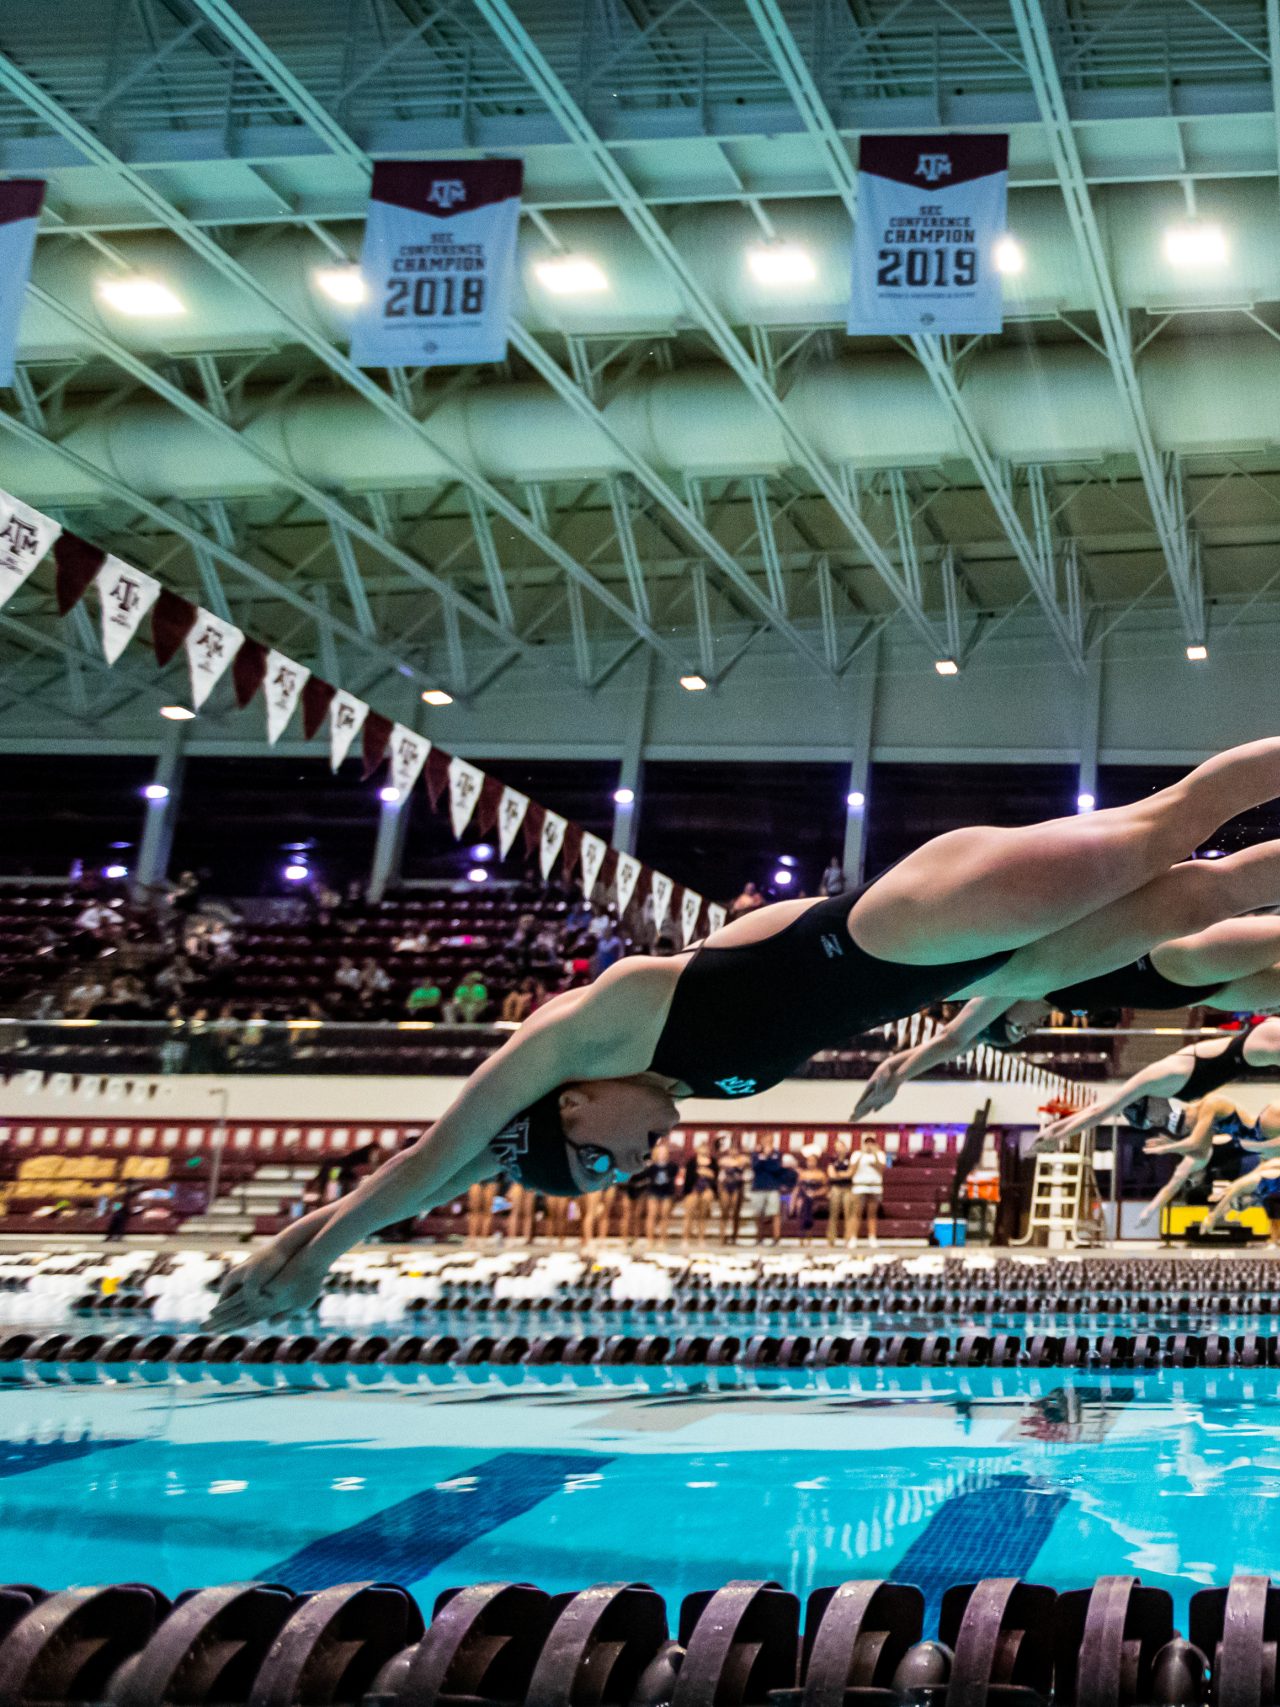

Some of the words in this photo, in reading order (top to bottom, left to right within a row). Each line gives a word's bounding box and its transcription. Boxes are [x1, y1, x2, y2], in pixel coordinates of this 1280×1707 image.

[919, 206, 943, 216] SEC
[889, 217, 971, 228] CONFERENCE
[884, 230, 976, 244] CHAMPION
[400, 244, 483, 256] CONFERENCE
[392, 257, 485, 272] CHAMPION
[877, 249, 977, 287] 2019
[384, 277, 484, 318] 2018
